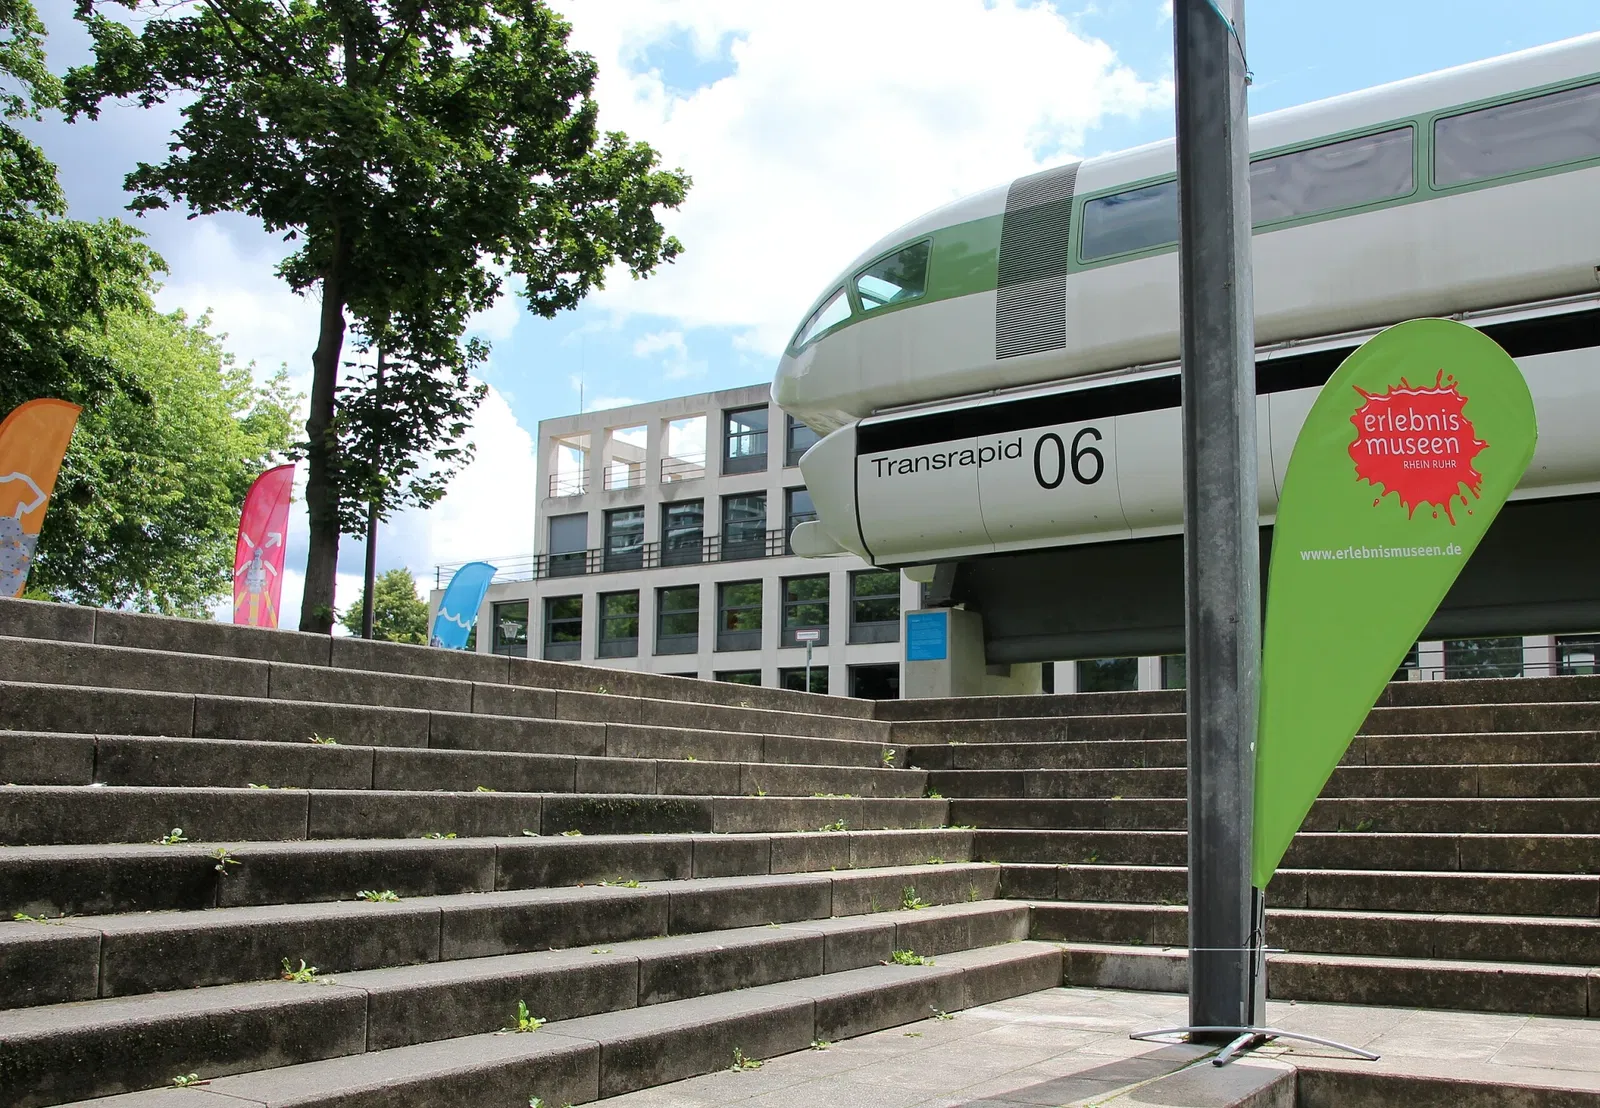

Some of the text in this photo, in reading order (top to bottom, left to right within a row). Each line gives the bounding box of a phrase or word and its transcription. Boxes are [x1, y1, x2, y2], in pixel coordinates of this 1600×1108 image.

[1364, 407, 1460, 432] erlebnis
[1364, 436, 1460, 455] museen
[871, 427, 1105, 489] Transrapid 06
[1403, 459, 1457, 469] RHEIN RUHR
[1300, 542, 1462, 561] www.erlebnismuseen.de
